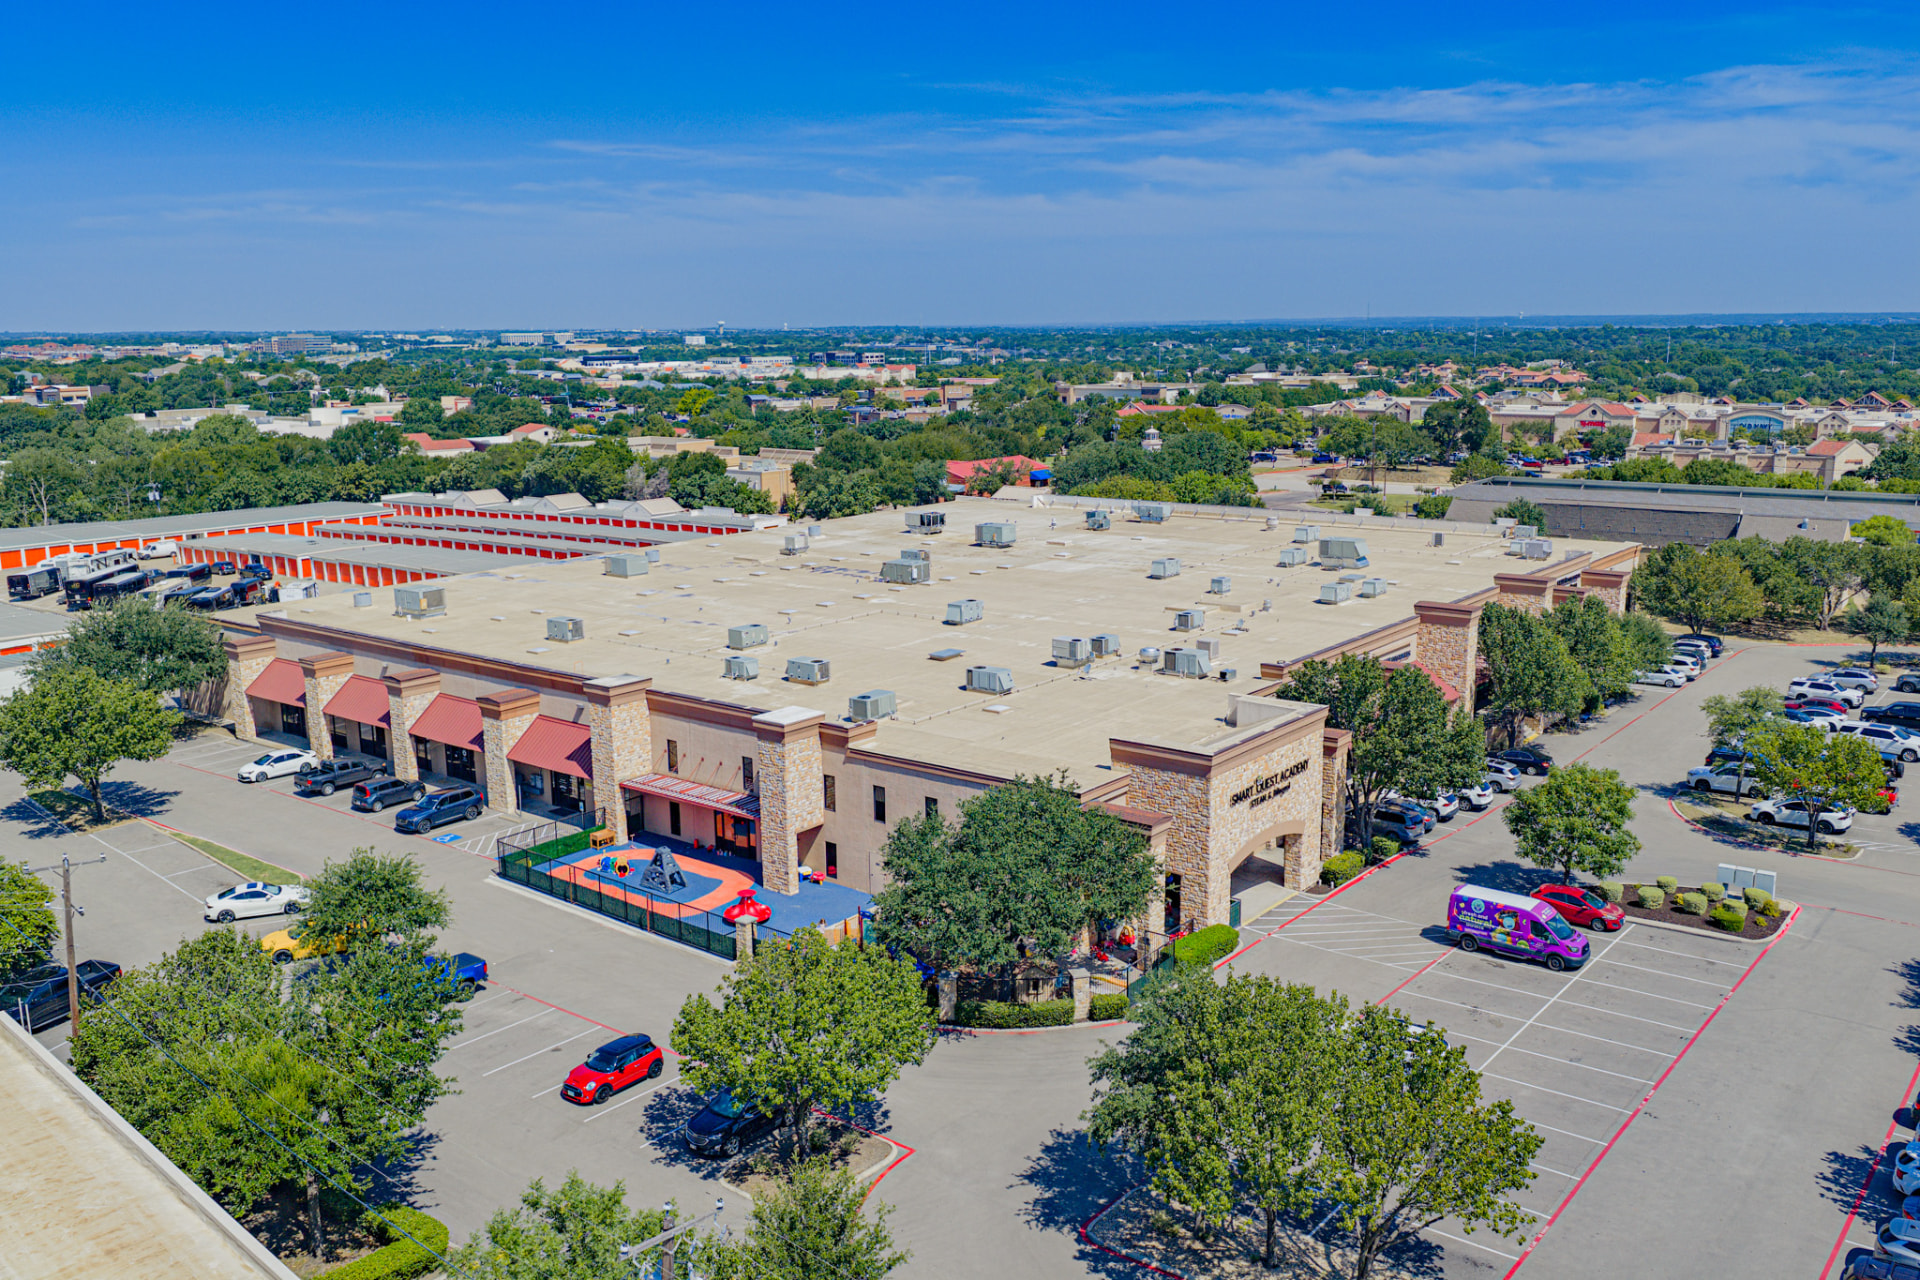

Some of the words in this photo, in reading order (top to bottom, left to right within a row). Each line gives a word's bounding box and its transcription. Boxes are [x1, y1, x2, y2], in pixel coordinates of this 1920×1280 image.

[1231, 785, 1254, 806] SMART
[1256, 773, 1279, 793] QUEST
[1280, 758, 1309, 782] ACADEMY
